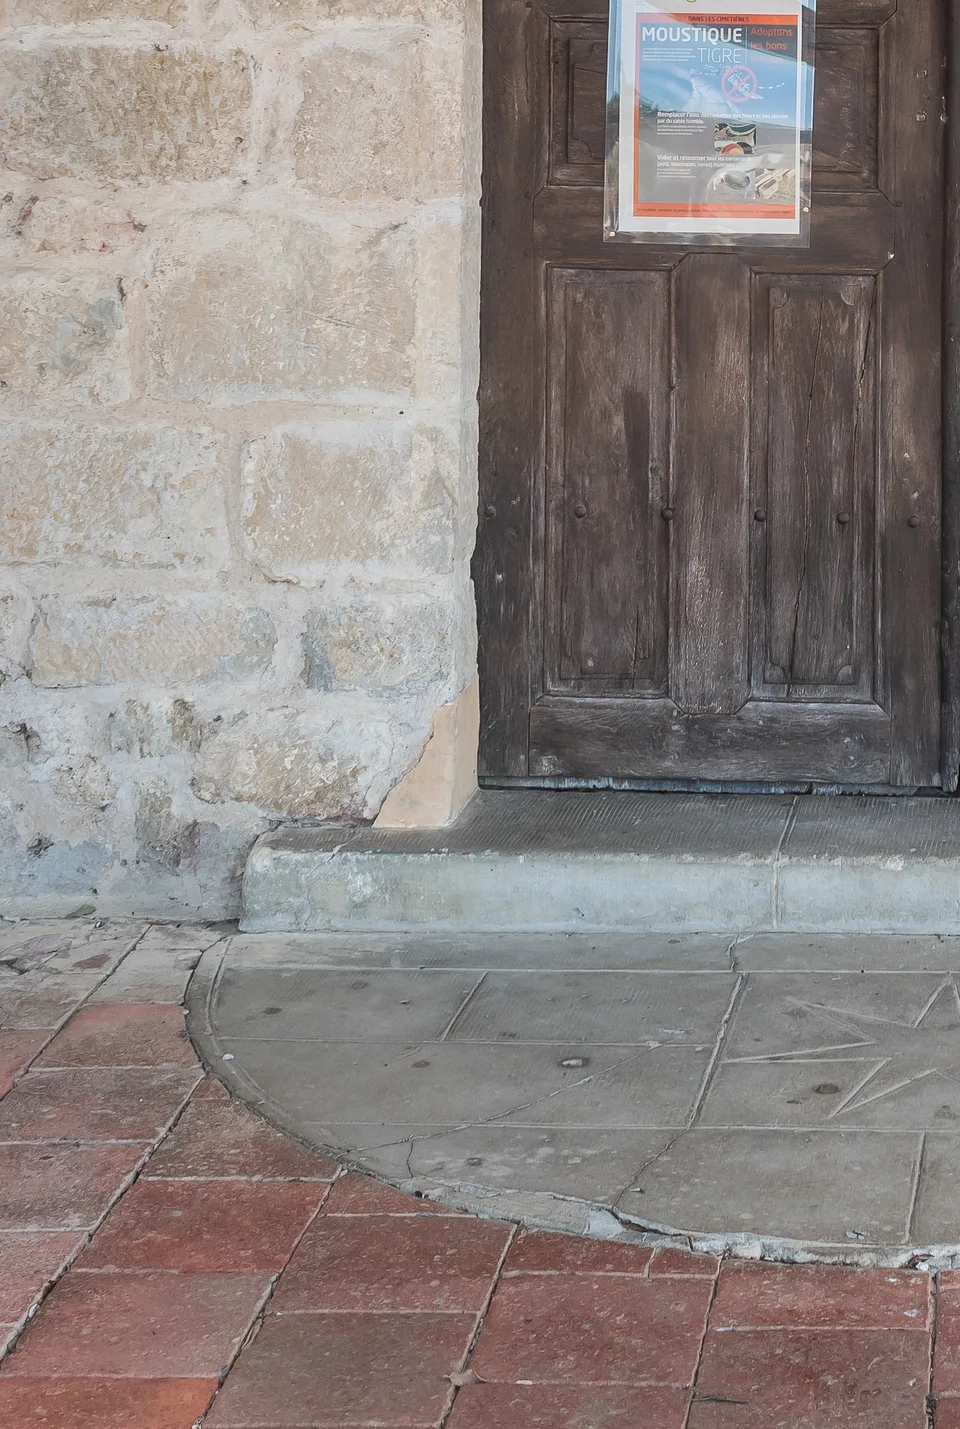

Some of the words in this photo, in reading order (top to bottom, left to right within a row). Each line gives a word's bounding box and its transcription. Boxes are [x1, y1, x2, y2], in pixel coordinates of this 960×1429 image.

[641, 26, 743, 45] MOUSTIQUE
[750, 27, 793, 38] Adoptons
[766, 41, 788, 51] bons
[697, 47, 742, 64] TIGRE
